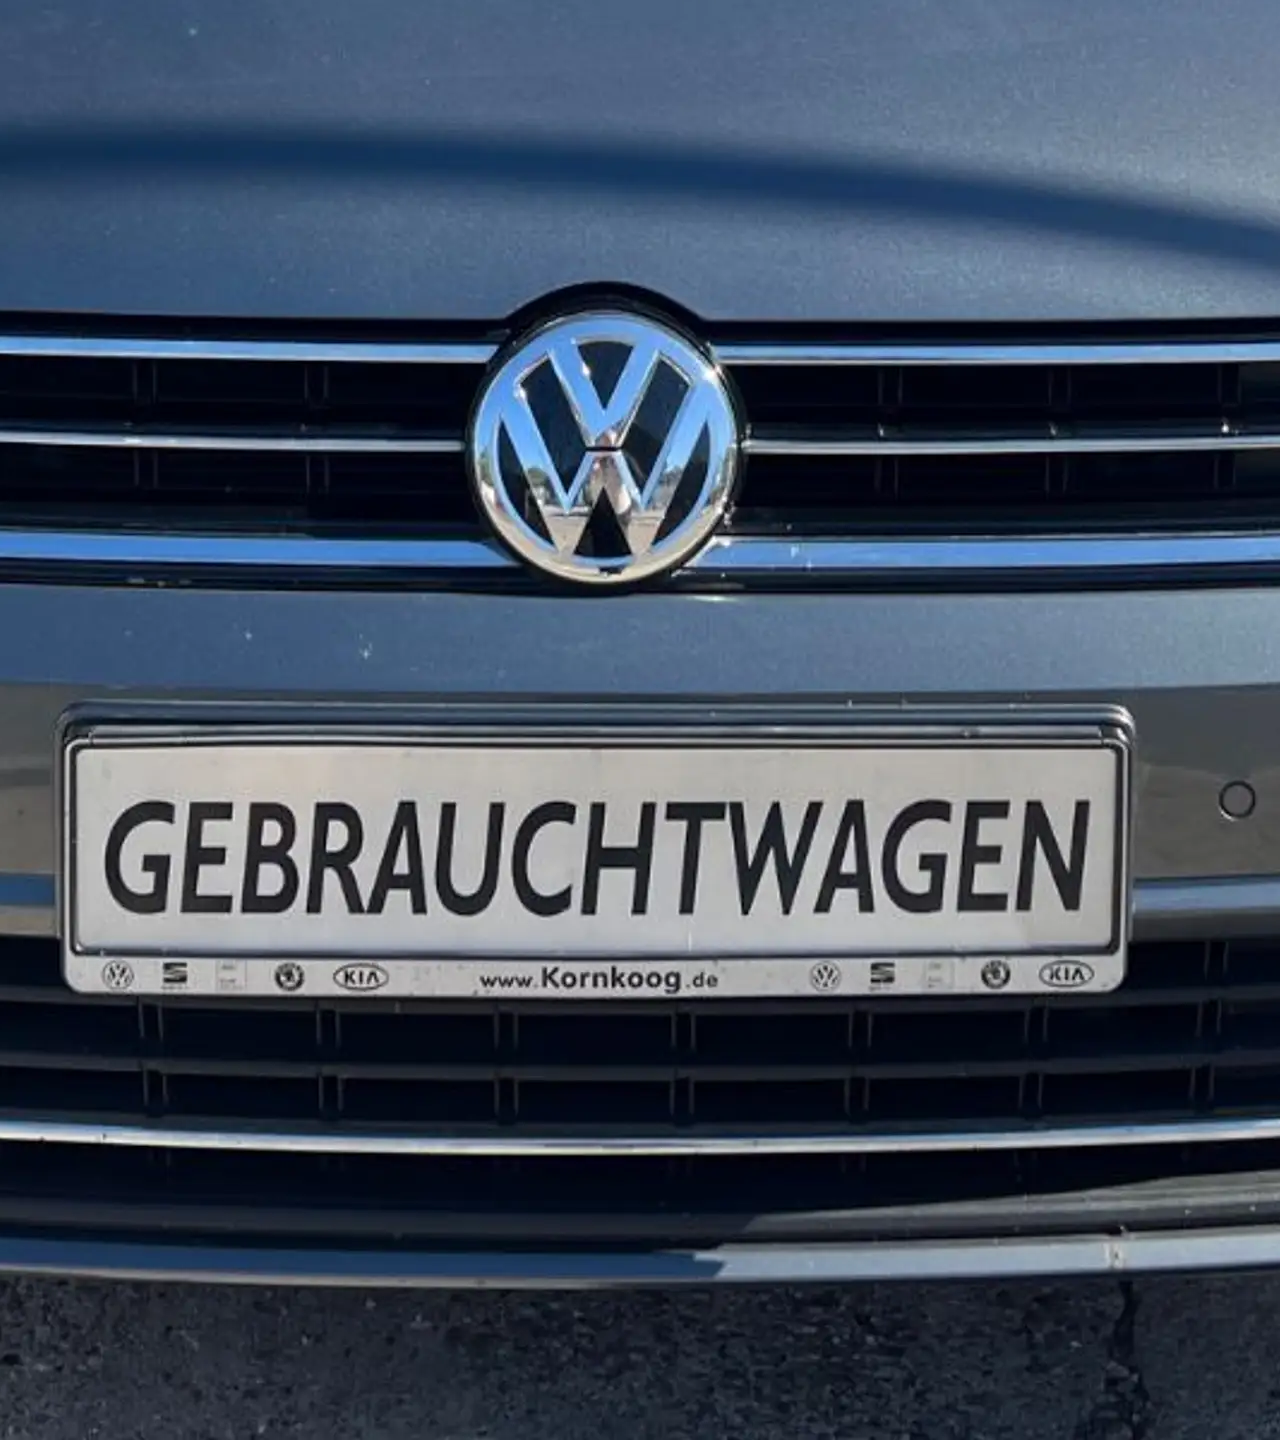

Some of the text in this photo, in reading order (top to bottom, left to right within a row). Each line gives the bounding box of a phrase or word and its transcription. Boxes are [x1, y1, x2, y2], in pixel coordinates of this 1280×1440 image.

[104, 799, 1090, 917] GEBRAUCHTWAGEN
[344, 969, 380, 985] KIA
[480, 966, 719, 994] www.Kornkoog.de
